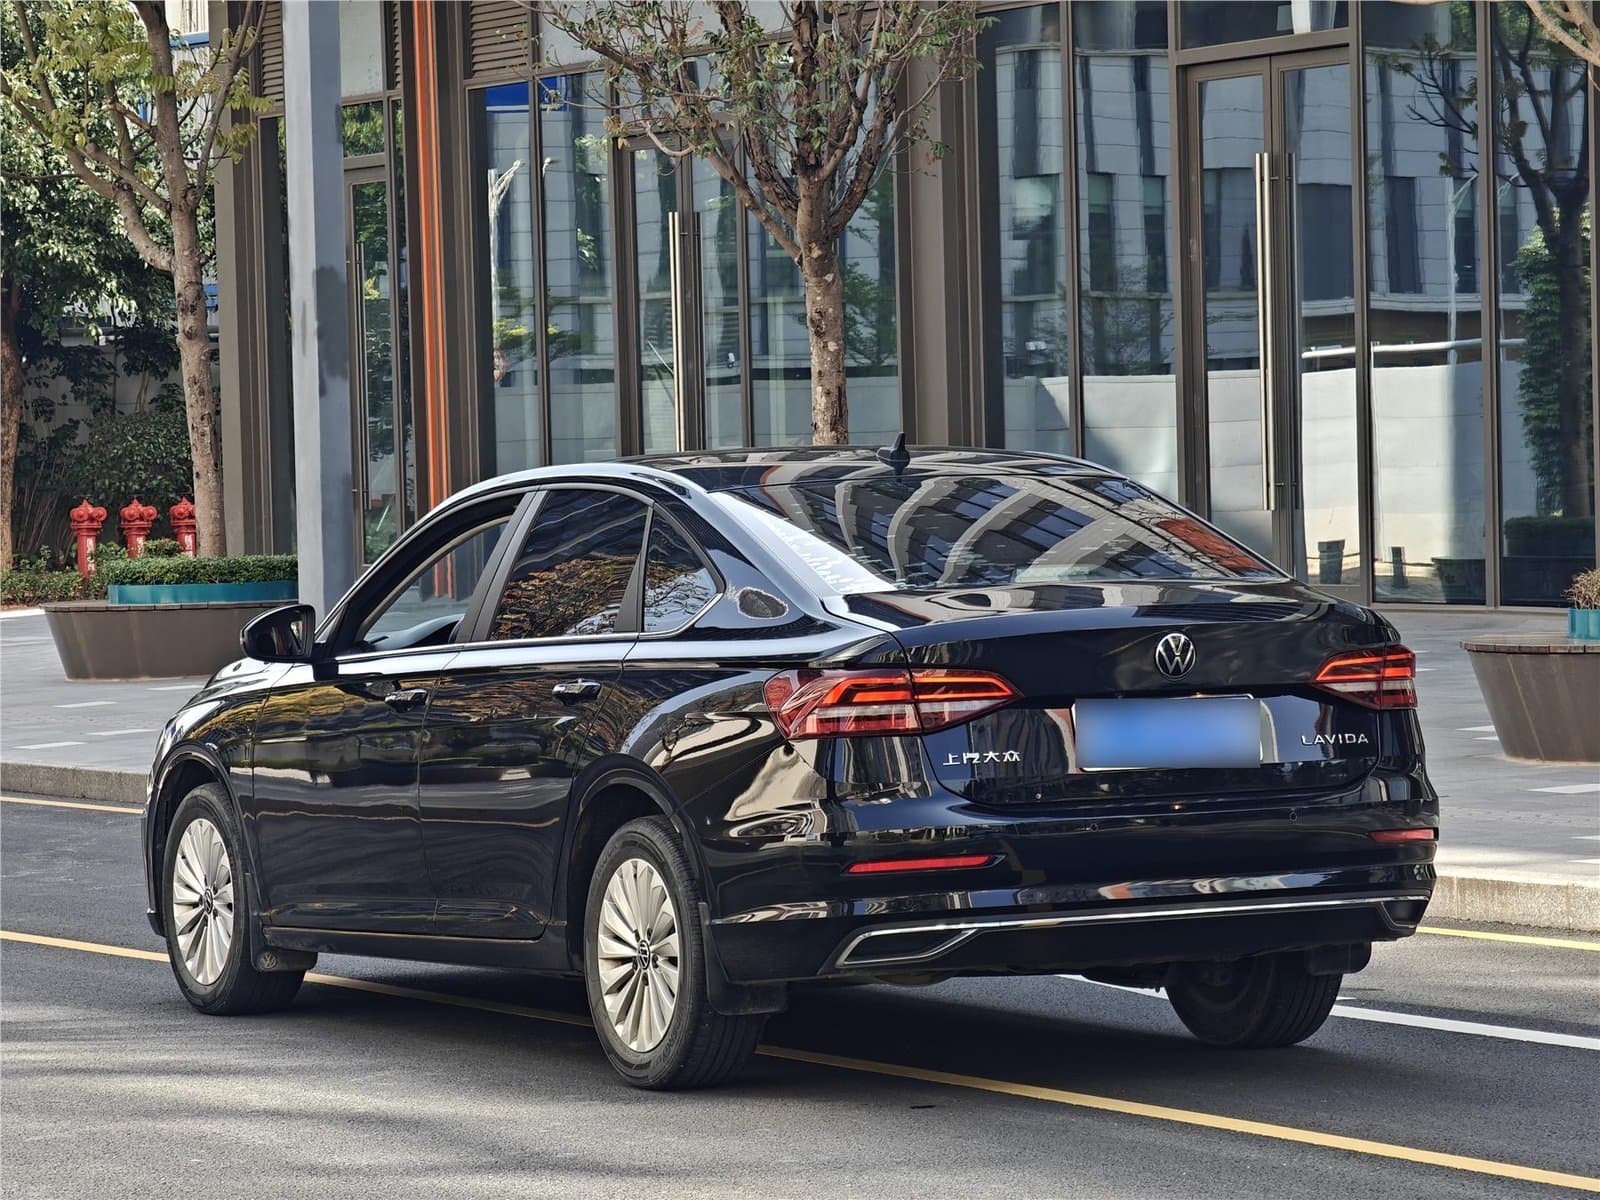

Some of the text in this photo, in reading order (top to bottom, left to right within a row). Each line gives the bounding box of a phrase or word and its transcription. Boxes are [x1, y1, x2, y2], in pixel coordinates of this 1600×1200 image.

[1156, 632, 1195, 678] VW
[1301, 733, 1369, 745] LAVIDA
[942, 750, 1021, 766] 上汽大众
